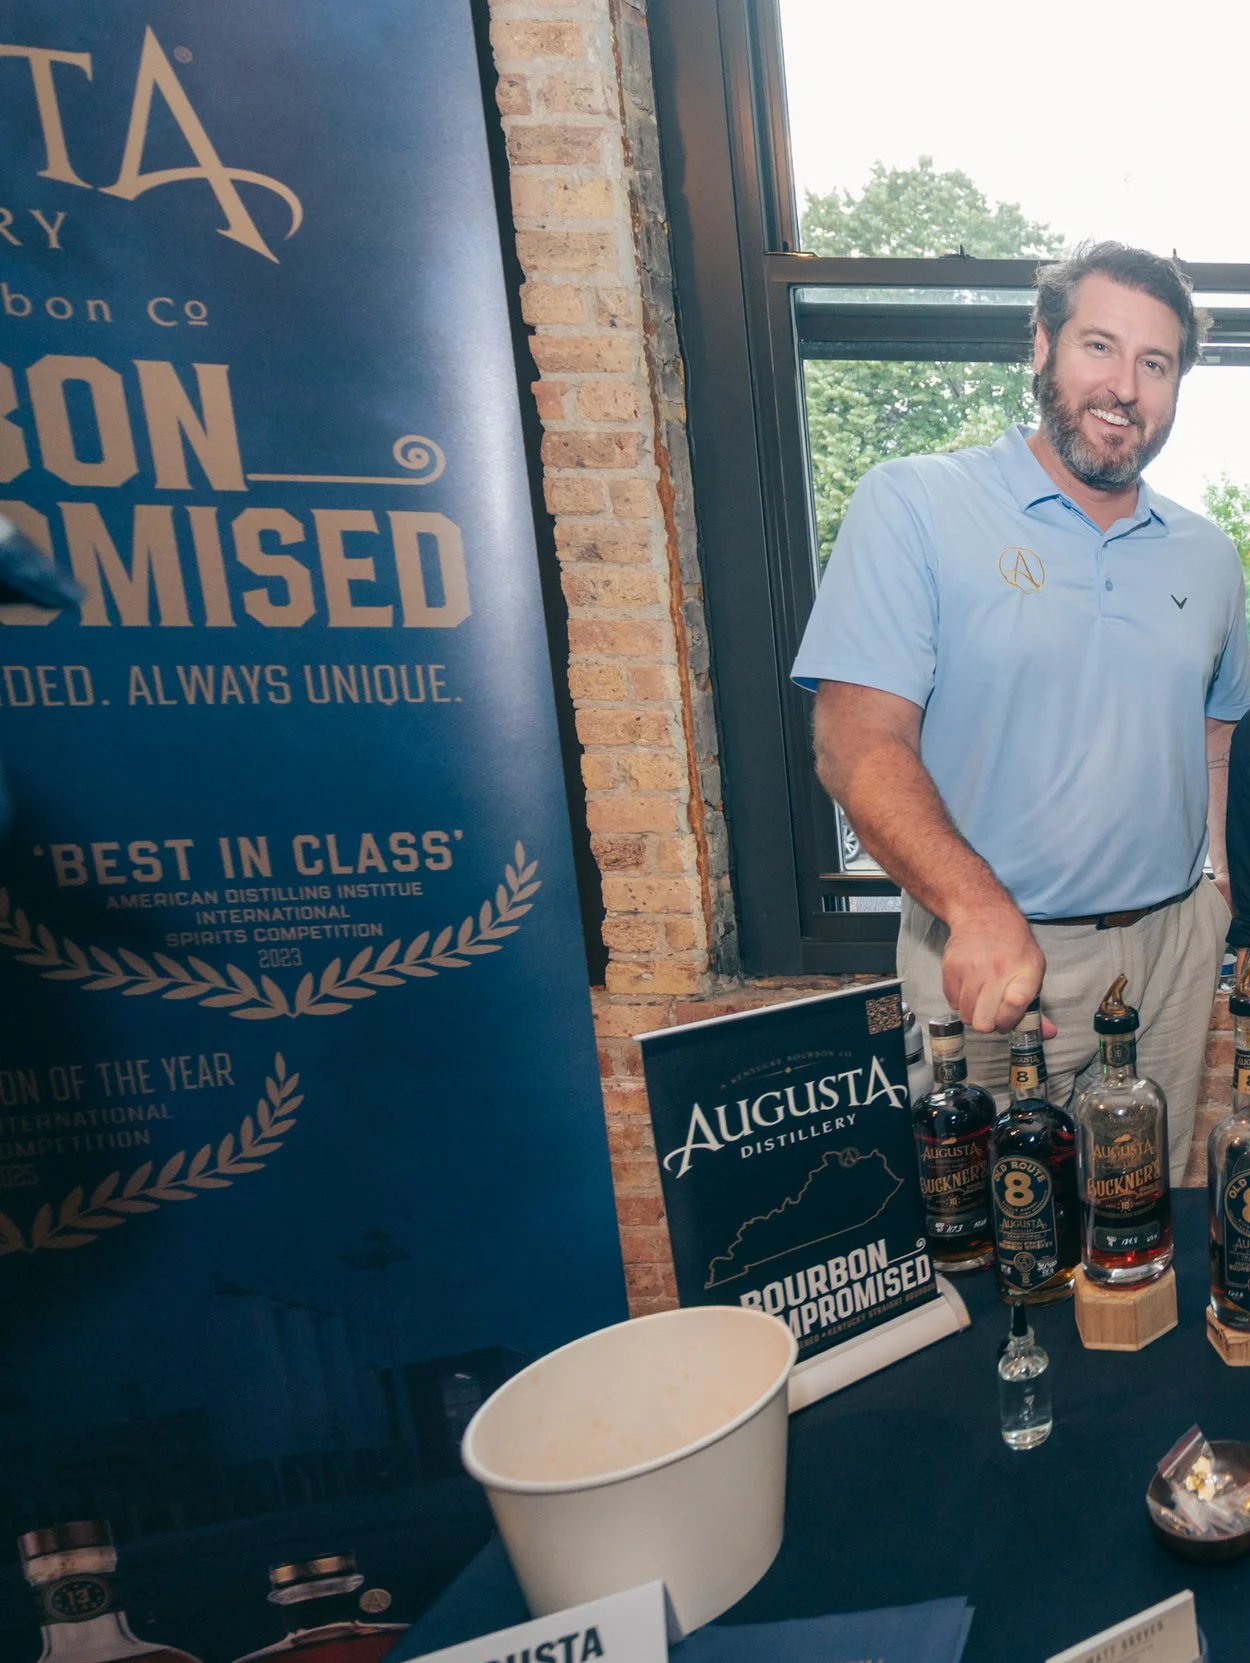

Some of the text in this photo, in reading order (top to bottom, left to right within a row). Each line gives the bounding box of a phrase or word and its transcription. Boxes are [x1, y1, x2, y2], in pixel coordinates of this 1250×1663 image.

[0, 207, 67, 248] RY
[3, 664, 463, 707] DED. ALWAYS UNIQUE.
[219, 835, 273, 879] IN
[105, 881, 424, 911] AMERICAN DISTILLING INSTITUE
[195, 905, 351, 925] INTERNATIONAL
[165, 923, 384, 948] SPIRITS COMPETITION
[258, 948, 303, 969] 2023
[49, 1065, 86, 1102] OF
[95, 1059, 156, 1097] THE
[160, 1052, 236, 1091] YEAR
[1016, 1071, 1029, 1083] 8
[663, 1055, 908, 1179] AUGUSTA
[740, 1113, 857, 1159] DISTILLERY
[1091, 1139, 1156, 1160] AUGUSTA
[920, 1141, 980, 1161] AUGUSTA
[994, 1161, 1047, 1183] OLD ROUTE
[1004, 1171, 1034, 1207] 8
[1228, 1178, 1247, 1199] OLD
[1000, 1218, 1048, 1230] AUGUSTA
[740, 1238, 889, 1316] BOURBON
